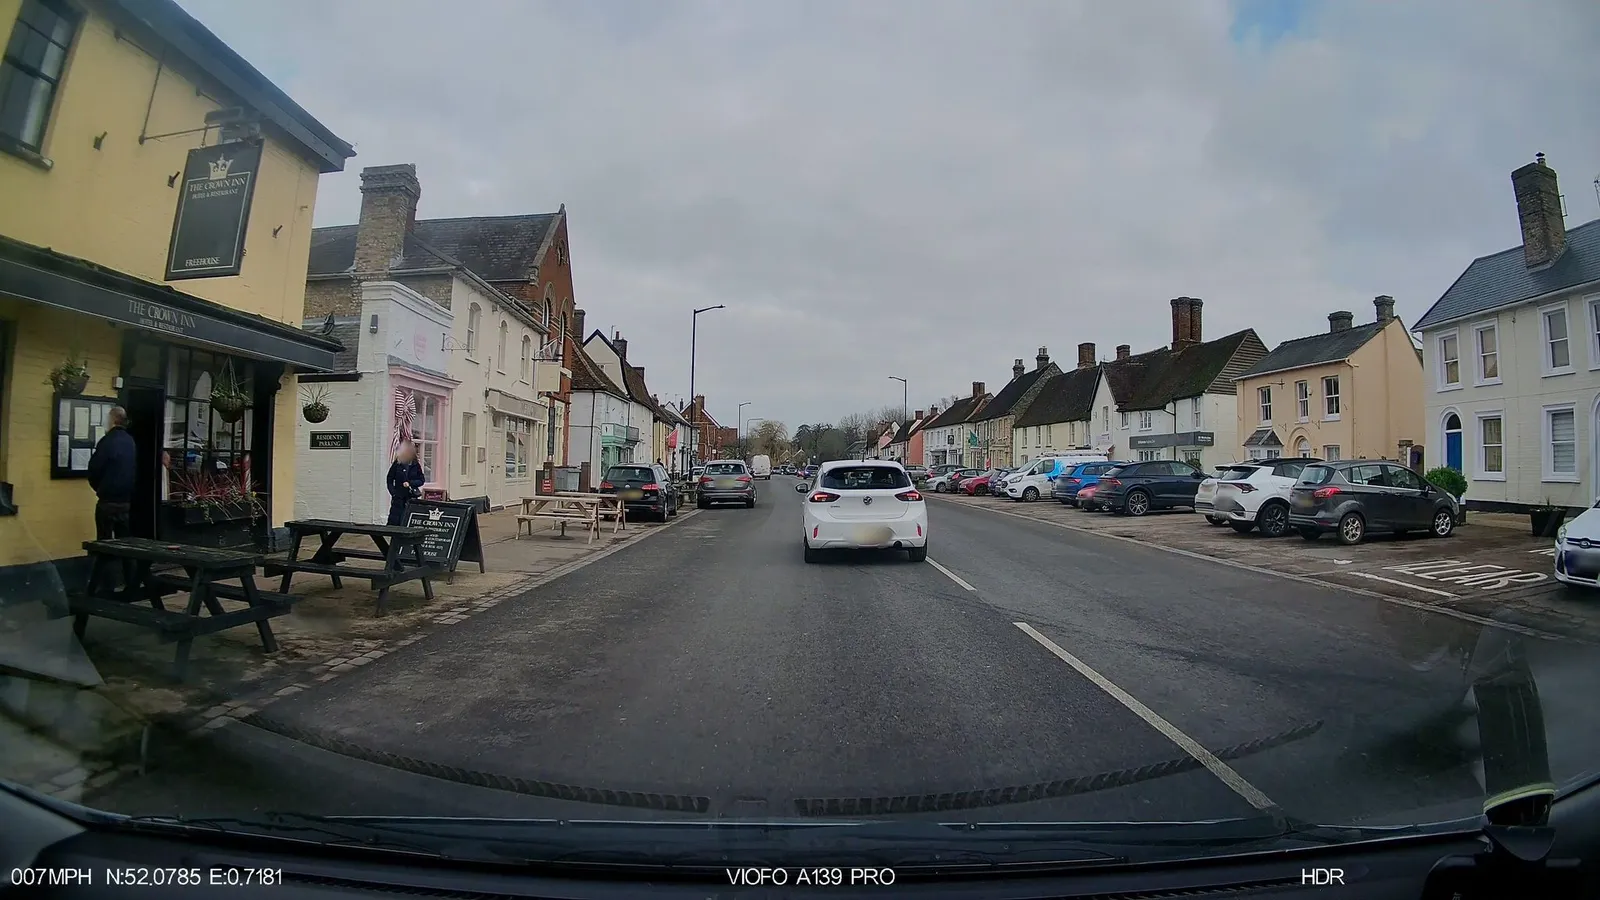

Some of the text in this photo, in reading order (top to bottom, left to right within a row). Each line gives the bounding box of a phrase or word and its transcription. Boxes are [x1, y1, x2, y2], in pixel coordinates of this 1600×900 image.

[189, 177, 247, 192] THE CROWN INN
[185, 256, 220, 267] FREEHOUSE
[128, 299, 196, 329] THE CROWN INN
[1381, 559, 1548, 590] CLEAR
